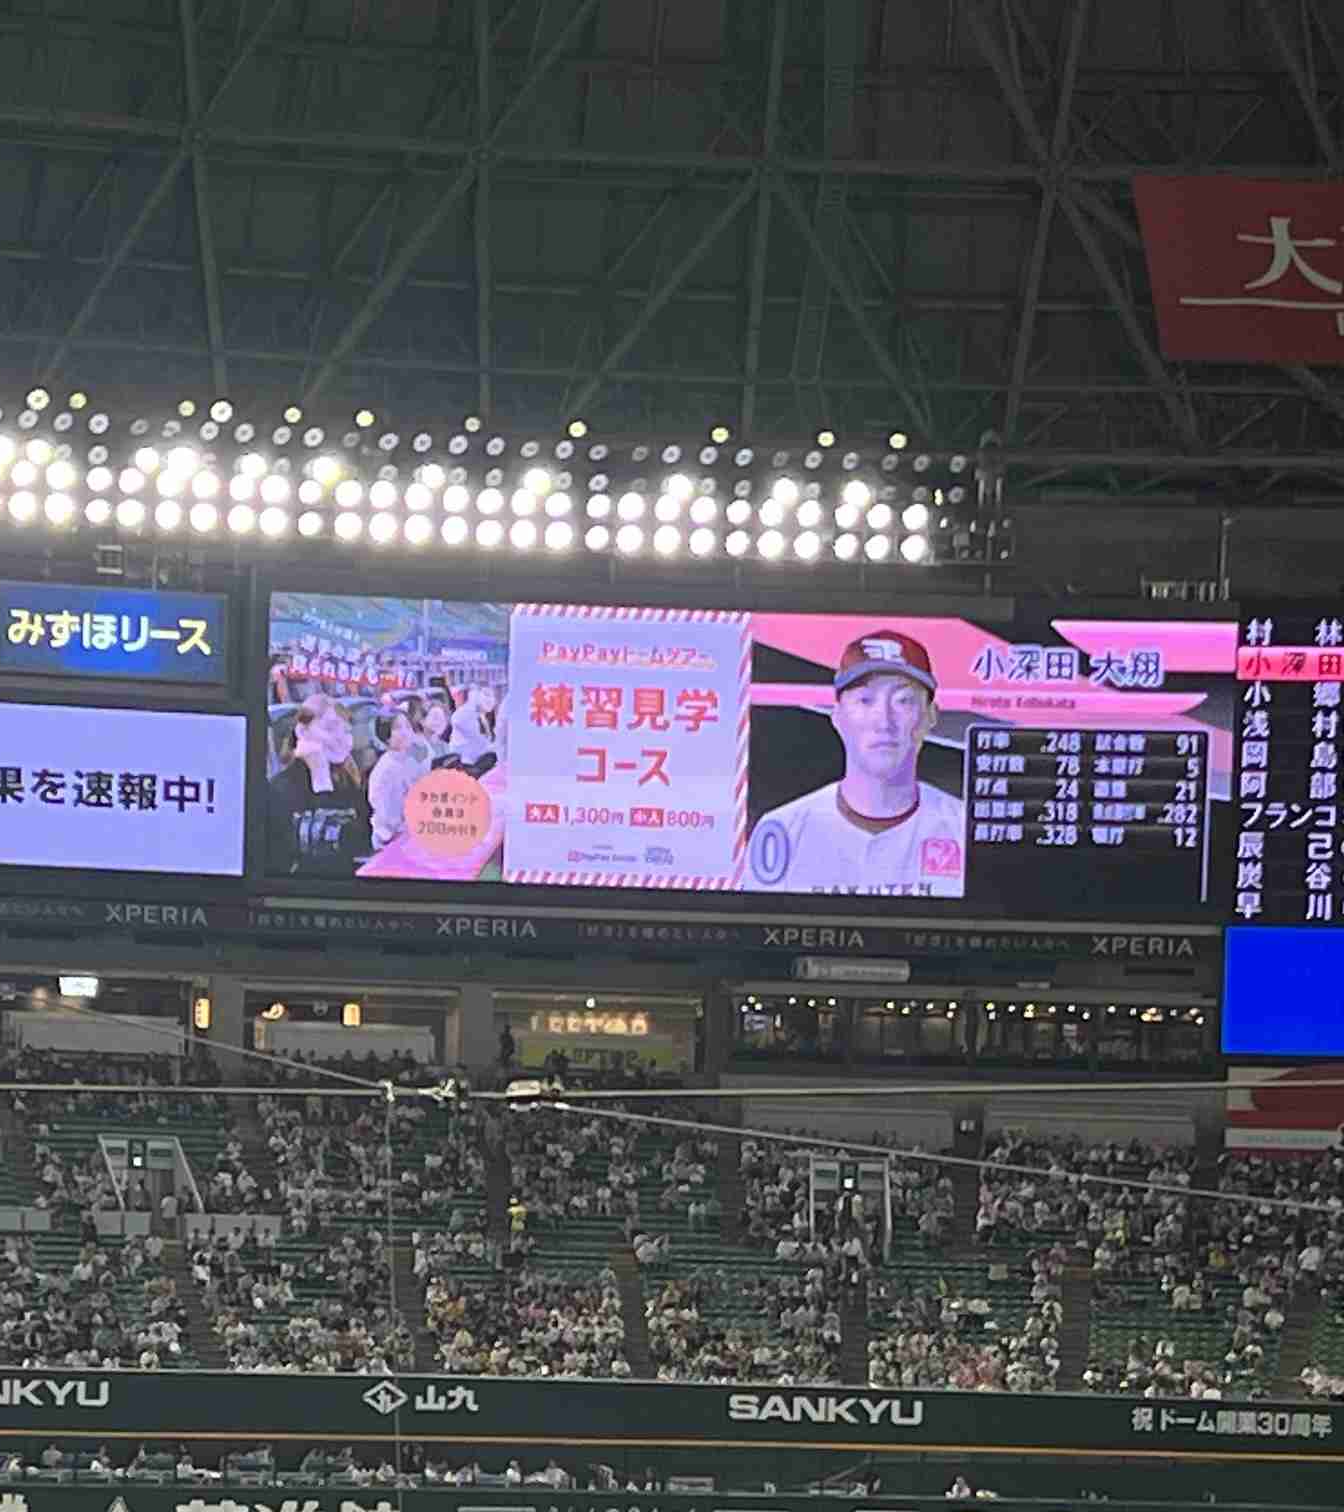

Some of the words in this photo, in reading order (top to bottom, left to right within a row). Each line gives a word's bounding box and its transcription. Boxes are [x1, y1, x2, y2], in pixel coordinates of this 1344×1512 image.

[6, 608, 213, 657] みずほリース
[1247, 618, 1344, 647] 村林
[972, 648, 1075, 681] 小深田
[530, 683, 719, 732] 練習見学
[1242, 709, 1339, 739] 浅村
[1040, 732, 1081, 753] .248
[1176, 735, 1199, 755] 91
[576, 747, 671, 786] コース
[1186, 757, 1200, 778] 5
[1056, 778, 1080, 799] 24
[1175, 781, 1198, 801] 21
[563, 806, 624, 826] 1,300円
[1038, 801, 1080, 822] .318
[1158, 804, 1198, 824] .282
[1239, 802, 1337, 829] フランコ
[1036, 824, 1079, 846] .328
[1173, 827, 1197, 847] 12
[105, 904, 209, 928] XPERIA
[1235, 891, 1333, 920] 早川
[435, 917, 537, 938] XPERIA
[763, 927, 865, 949] XPERIA
[1089, 934, 1195, 956] XPERIA
[415, 1385, 480, 1412] 山九
[728, 1394, 924, 1426] SANKYU
